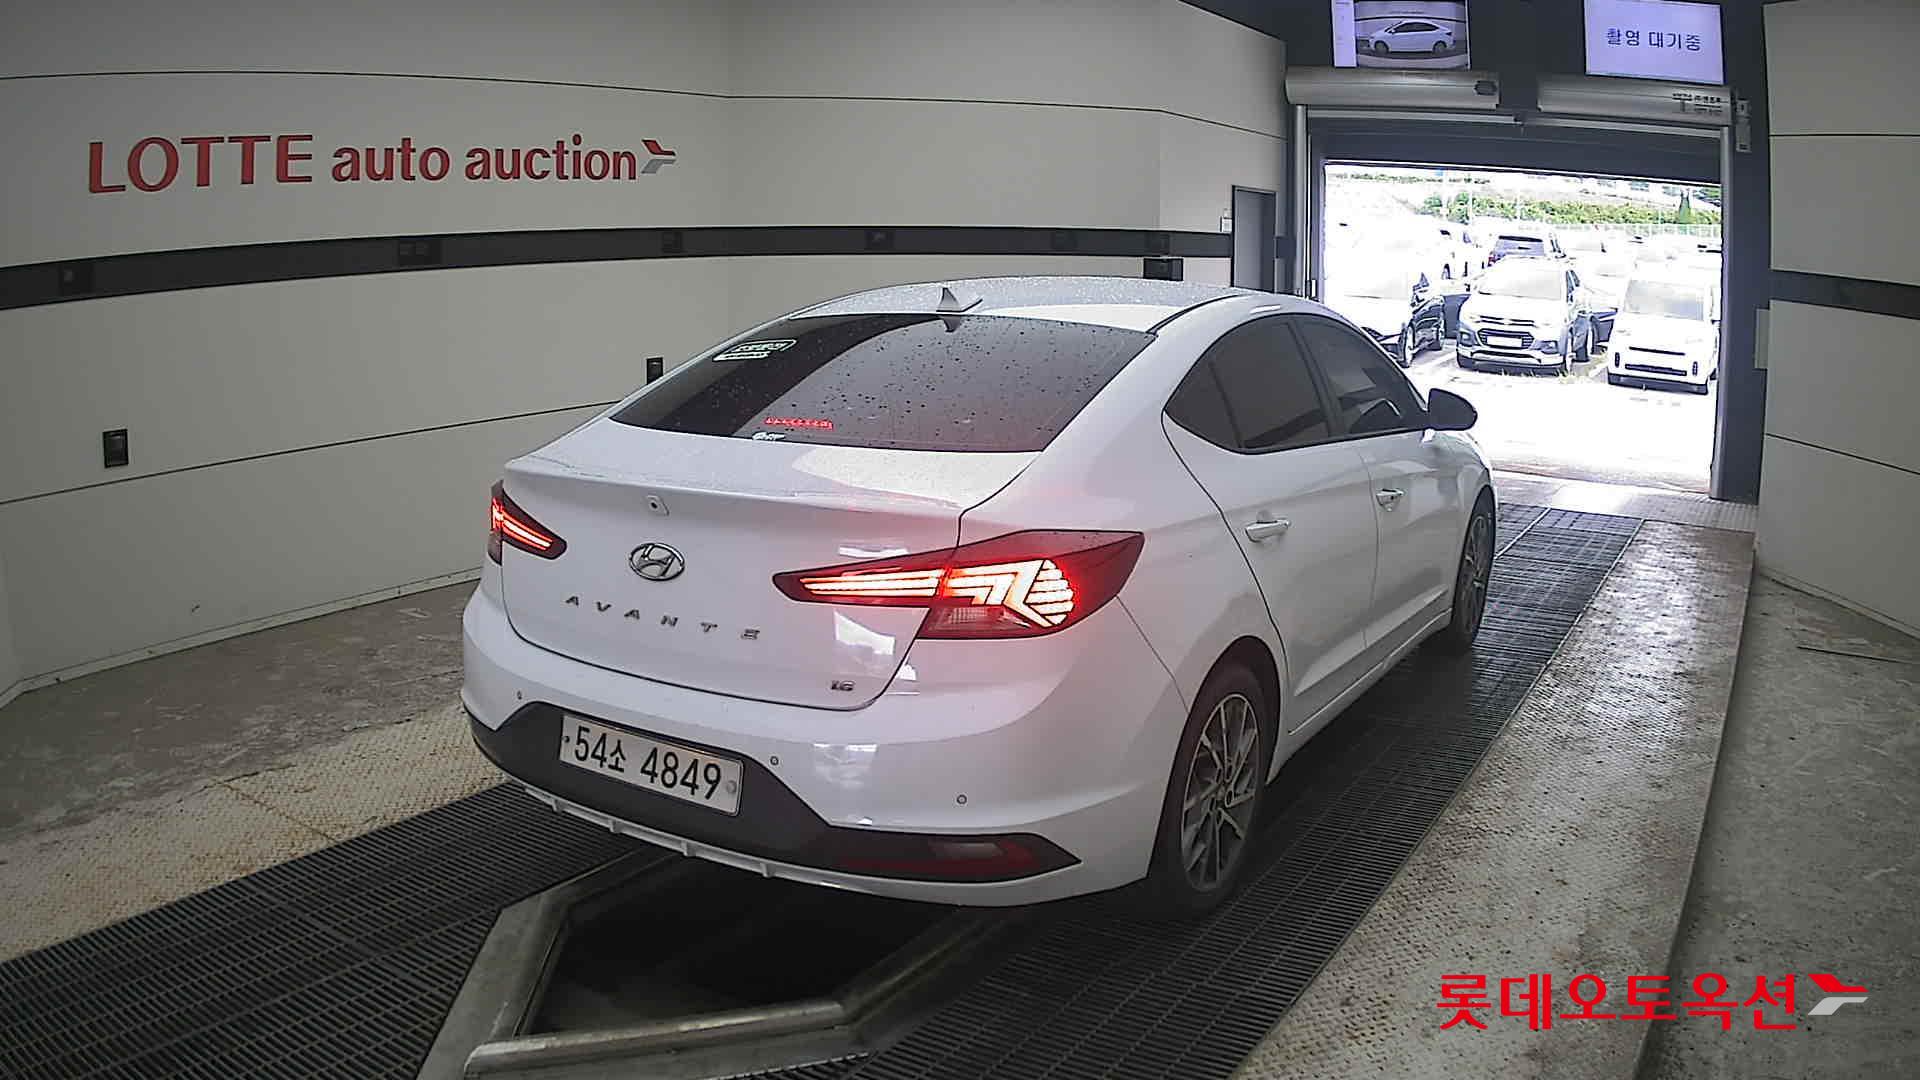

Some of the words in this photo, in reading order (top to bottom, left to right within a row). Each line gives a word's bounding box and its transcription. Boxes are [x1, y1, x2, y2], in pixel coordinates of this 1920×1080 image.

[1607, 28, 1640, 46] 촬영
[1648, 31, 1701, 51] 대기중
[88, 134, 313, 193] LOTTE
[332, 137, 450, 182] auto
[464, 133, 637, 181] auction
[565, 595, 760, 640] AVANTE
[574, 725, 626, 773] 54소
[640, 747, 722, 800] 4849
